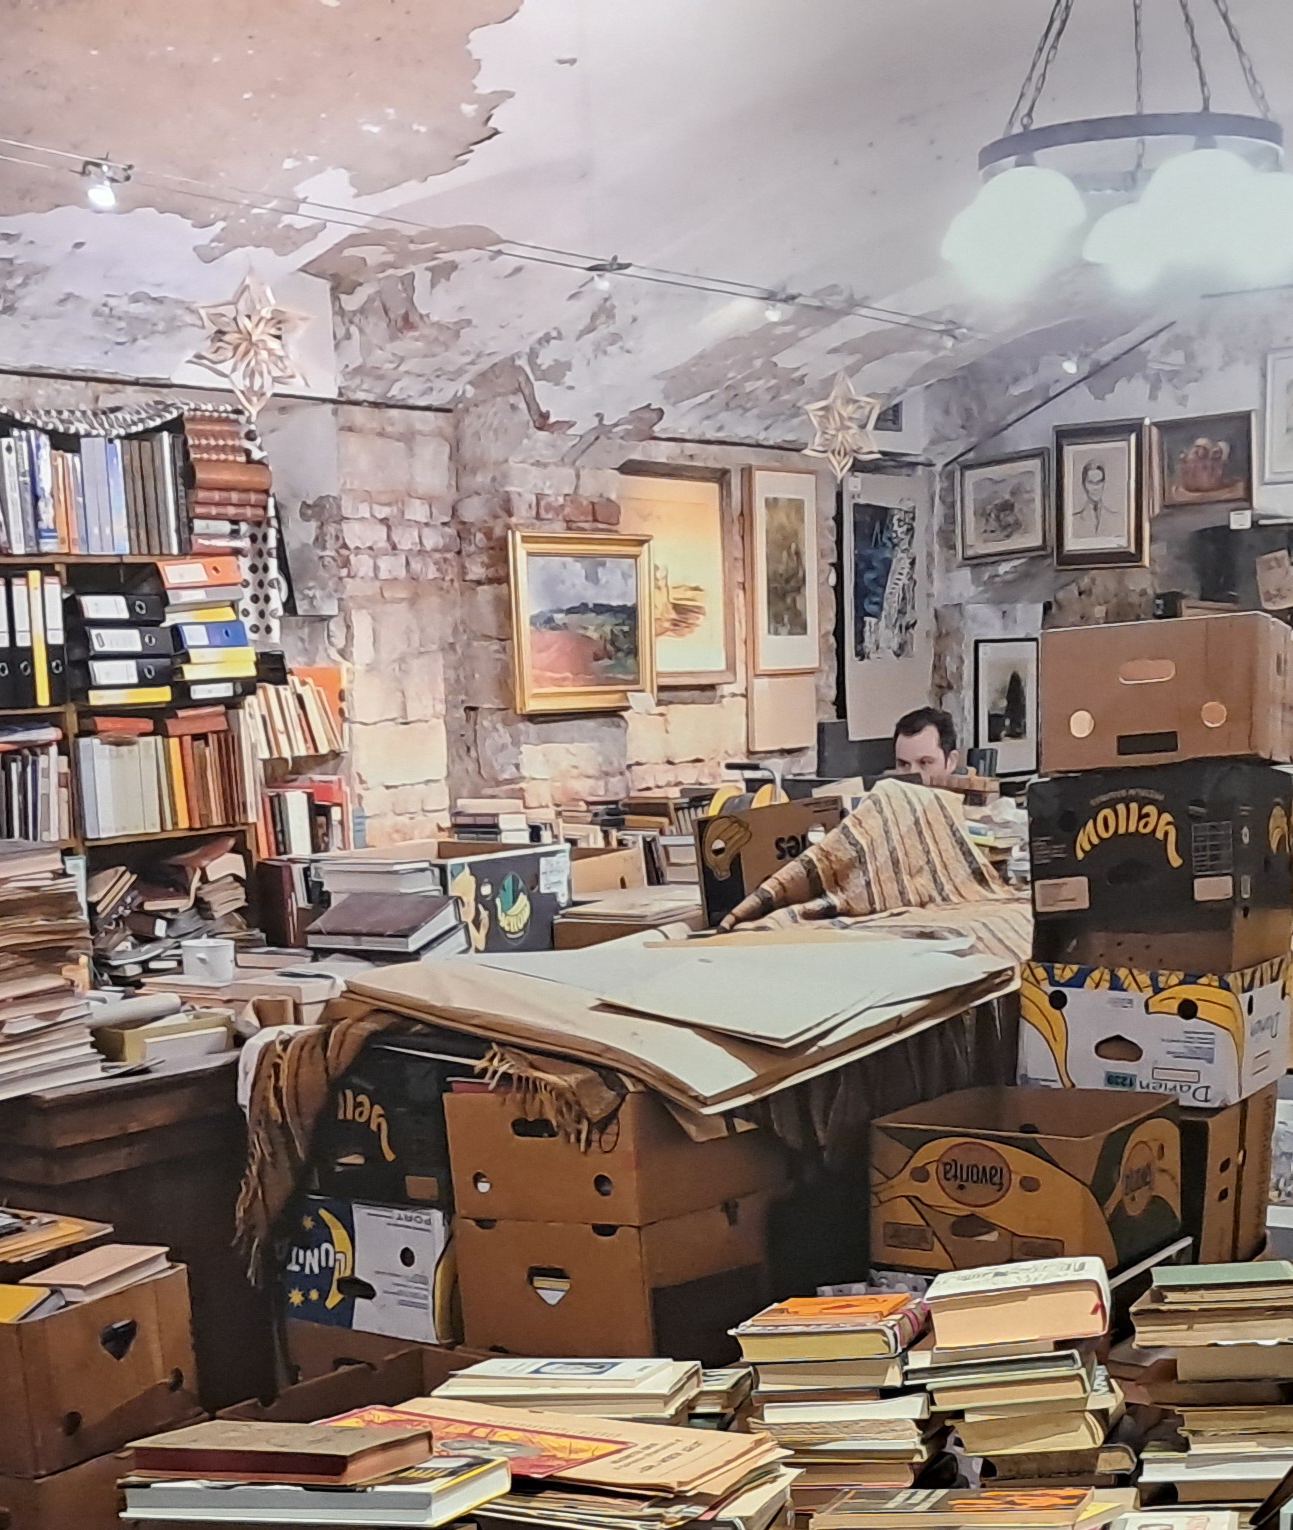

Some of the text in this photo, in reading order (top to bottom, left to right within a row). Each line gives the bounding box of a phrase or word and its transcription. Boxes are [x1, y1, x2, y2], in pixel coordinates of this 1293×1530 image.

[1075, 802, 1184, 869] yellow
[1137, 1080, 1211, 1103] Darien
[338, 1090, 398, 1163] yell
[942, 1159, 1005, 1192] favorita
